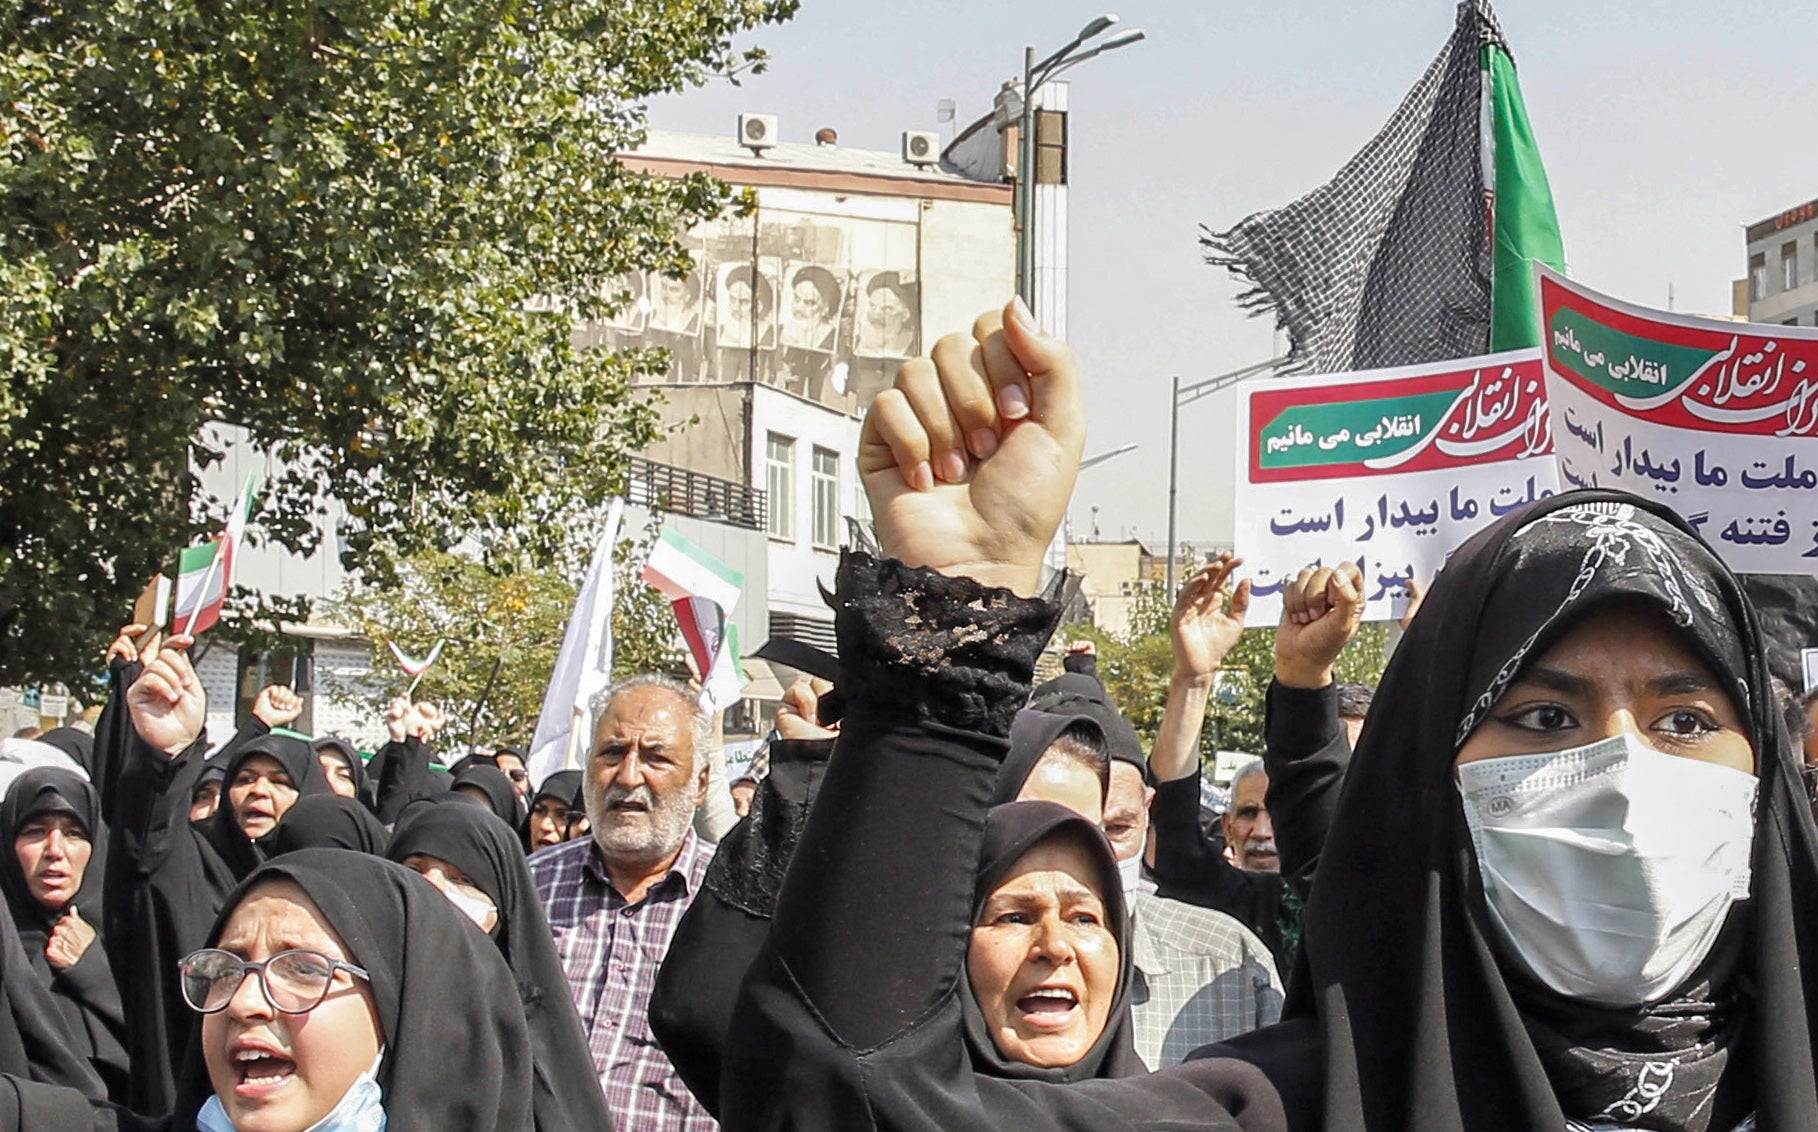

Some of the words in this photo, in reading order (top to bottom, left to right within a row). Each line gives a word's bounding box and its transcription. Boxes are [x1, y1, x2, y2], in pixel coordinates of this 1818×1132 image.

[1554, 326, 1581, 353] مانیم
[1583, 350, 1605, 367] می
[1608, 354, 1668, 385] انقلابی
[1613, 335, 1786, 411] انقلابی
[1355, 414, 1421, 447] انقلابی
[1363, 367, 1520, 470] انقلابی
[1563, 407, 1604, 454] است
[1267, 424, 1314, 454] مانیم
[1318, 428, 1350, 450] می
[1611, 435, 1681, 494] بیدار
[1693, 449, 1728, 486] ما
[1740, 454, 1818, 489] ملت
[1449, 486, 1479, 521] ما
[1489, 475, 1553, 516] ملت
[1270, 497, 1344, 536] است
[1355, 494, 1440, 542] بیدار
[1720, 510, 1791, 545] فتنه
